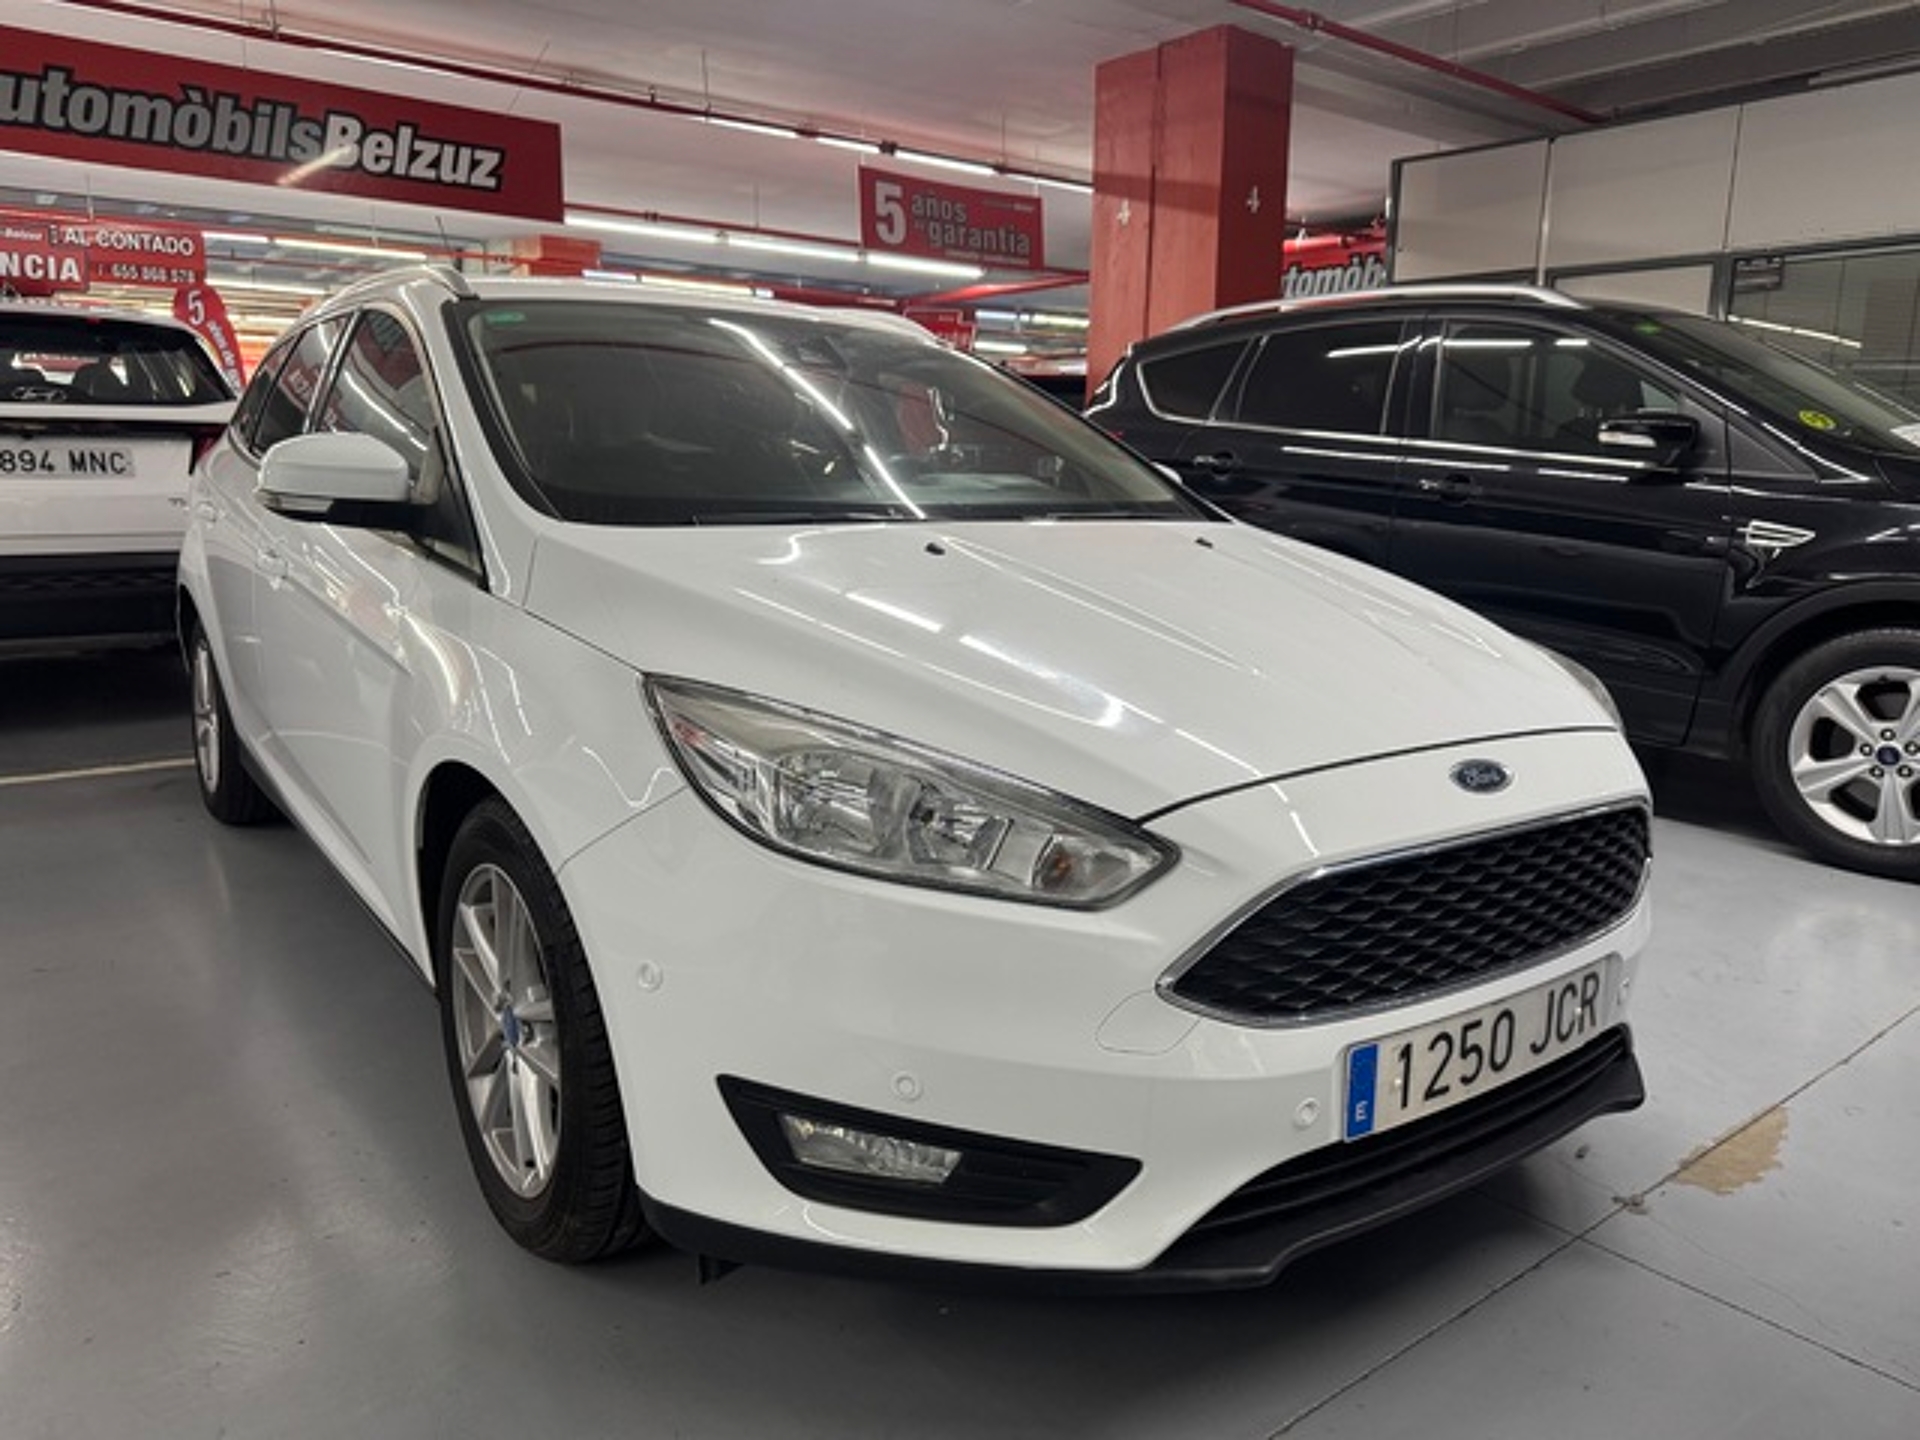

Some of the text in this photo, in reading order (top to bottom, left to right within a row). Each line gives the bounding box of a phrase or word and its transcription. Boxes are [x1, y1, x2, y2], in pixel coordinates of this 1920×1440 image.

[874, 180, 907, 245] 5
[63, 226, 194, 256] AL CONTADO
[187, 290, 205, 325] 5
[68, 450, 127, 475] MNC
[1397, 971, 1600, 1110] 1250 JCR
[1355, 1100, 1368, 1123] E
